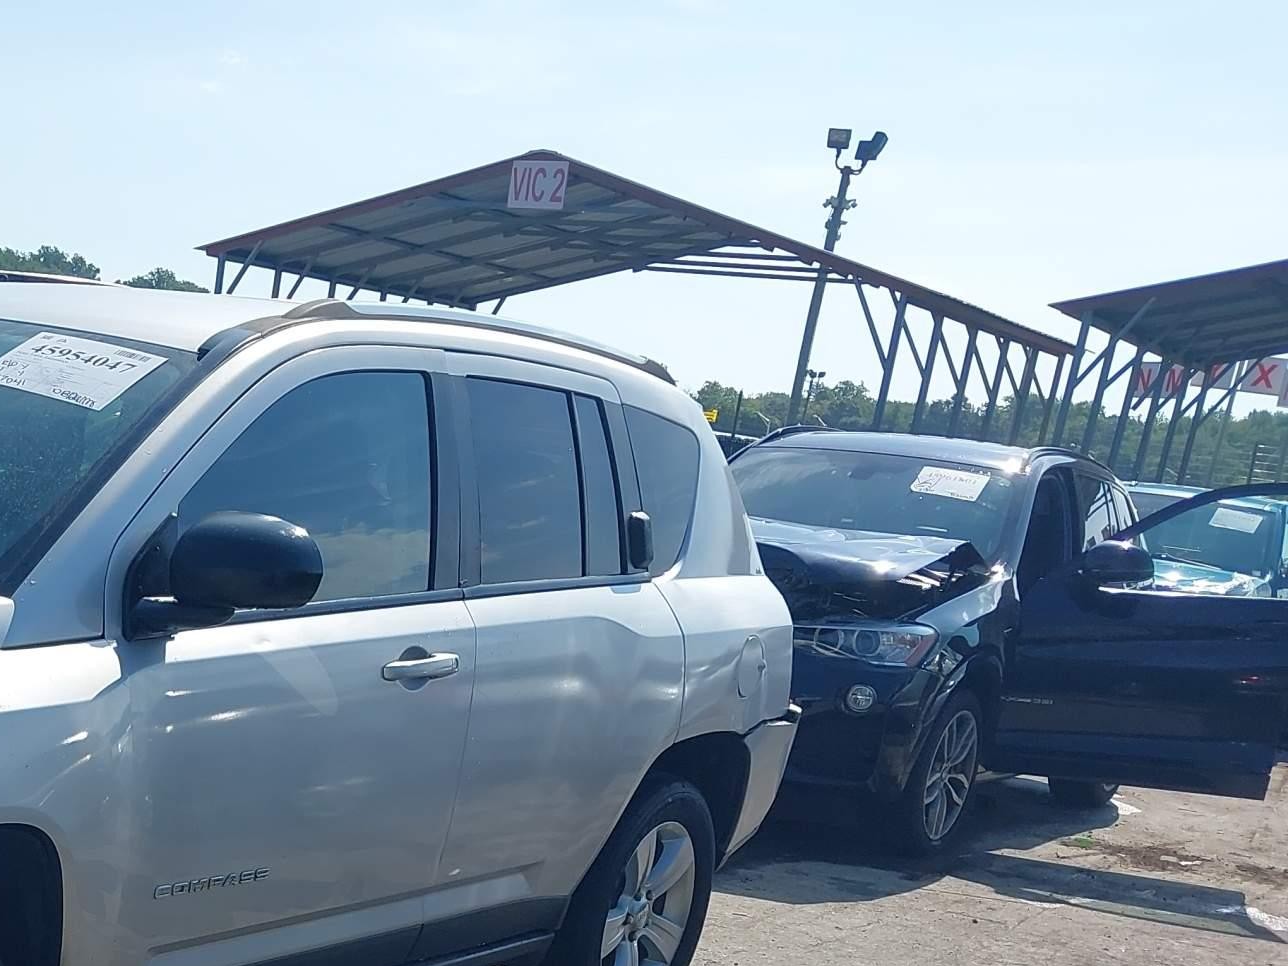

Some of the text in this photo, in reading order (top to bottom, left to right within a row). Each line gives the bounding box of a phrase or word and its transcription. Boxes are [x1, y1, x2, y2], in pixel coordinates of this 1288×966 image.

[513, 167, 565, 202] VIC 2
[31, 344, 139, 374] 45954047
[1250, 363, 1279, 389] X
[153, 866, 271, 899] COMPASS
